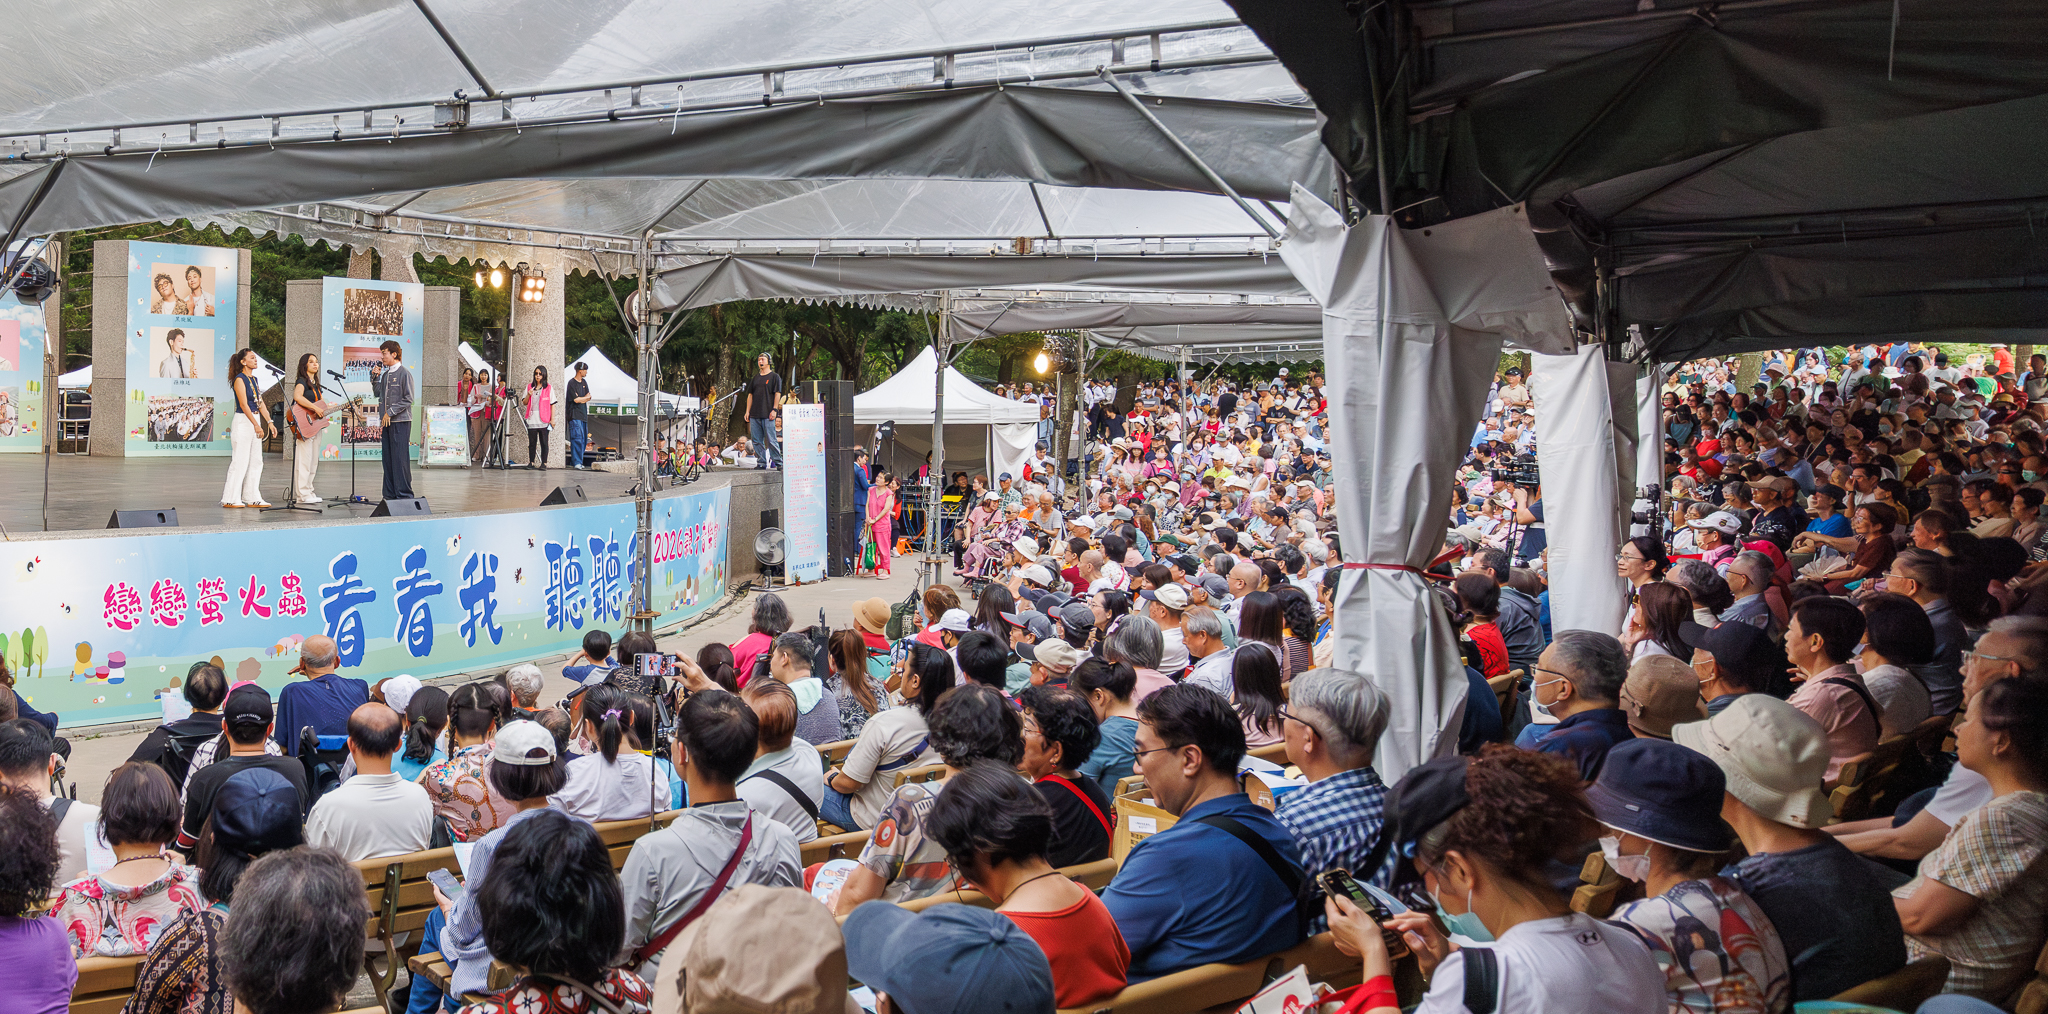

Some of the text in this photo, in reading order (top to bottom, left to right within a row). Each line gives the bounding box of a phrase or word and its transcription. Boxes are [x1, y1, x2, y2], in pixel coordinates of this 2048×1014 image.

[103, 571, 307, 631] 戀戀螢火蟲
[319, 545, 503, 667] 看看我
[654, 521, 719, 564] 2026親子音樂會
